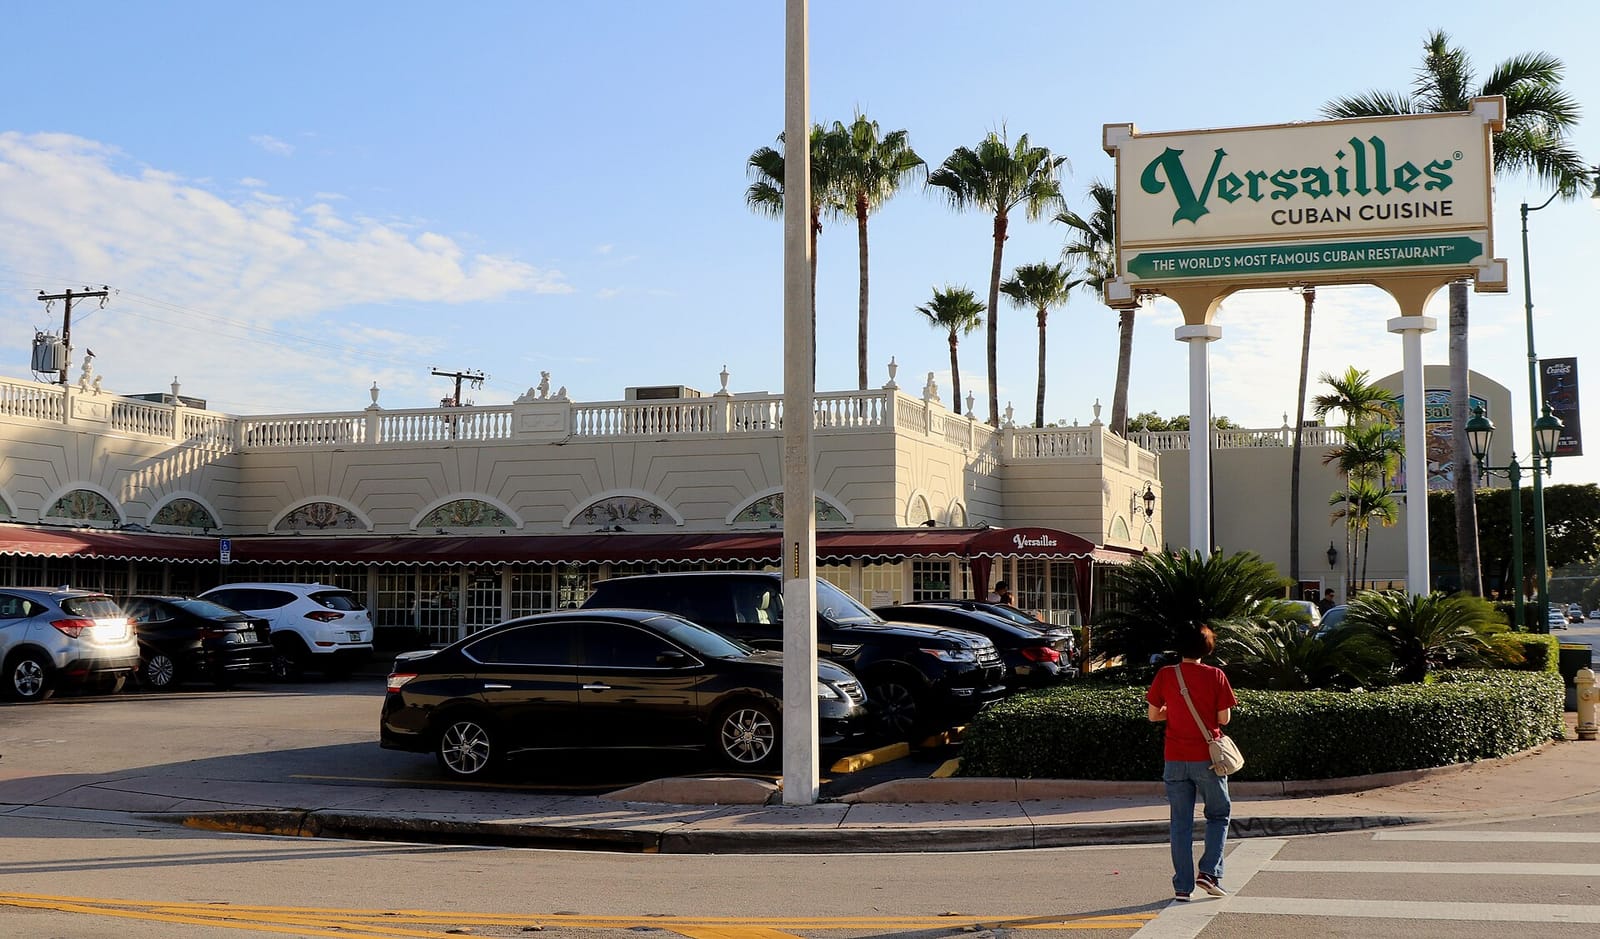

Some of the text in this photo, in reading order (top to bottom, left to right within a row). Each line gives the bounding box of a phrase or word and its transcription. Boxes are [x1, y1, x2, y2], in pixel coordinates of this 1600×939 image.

[1271, 200, 1454, 226] CUBAN CUISINE
[1152, 260, 1176, 271] THE
[1178, 256, 1231, 270] WORLD'S
[1234, 254, 1267, 267] MOST
[1270, 252, 1320, 266] FAMOUS
[1323, 250, 1365, 263] CUBAN
[1012, 533, 1057, 549] Versailles
